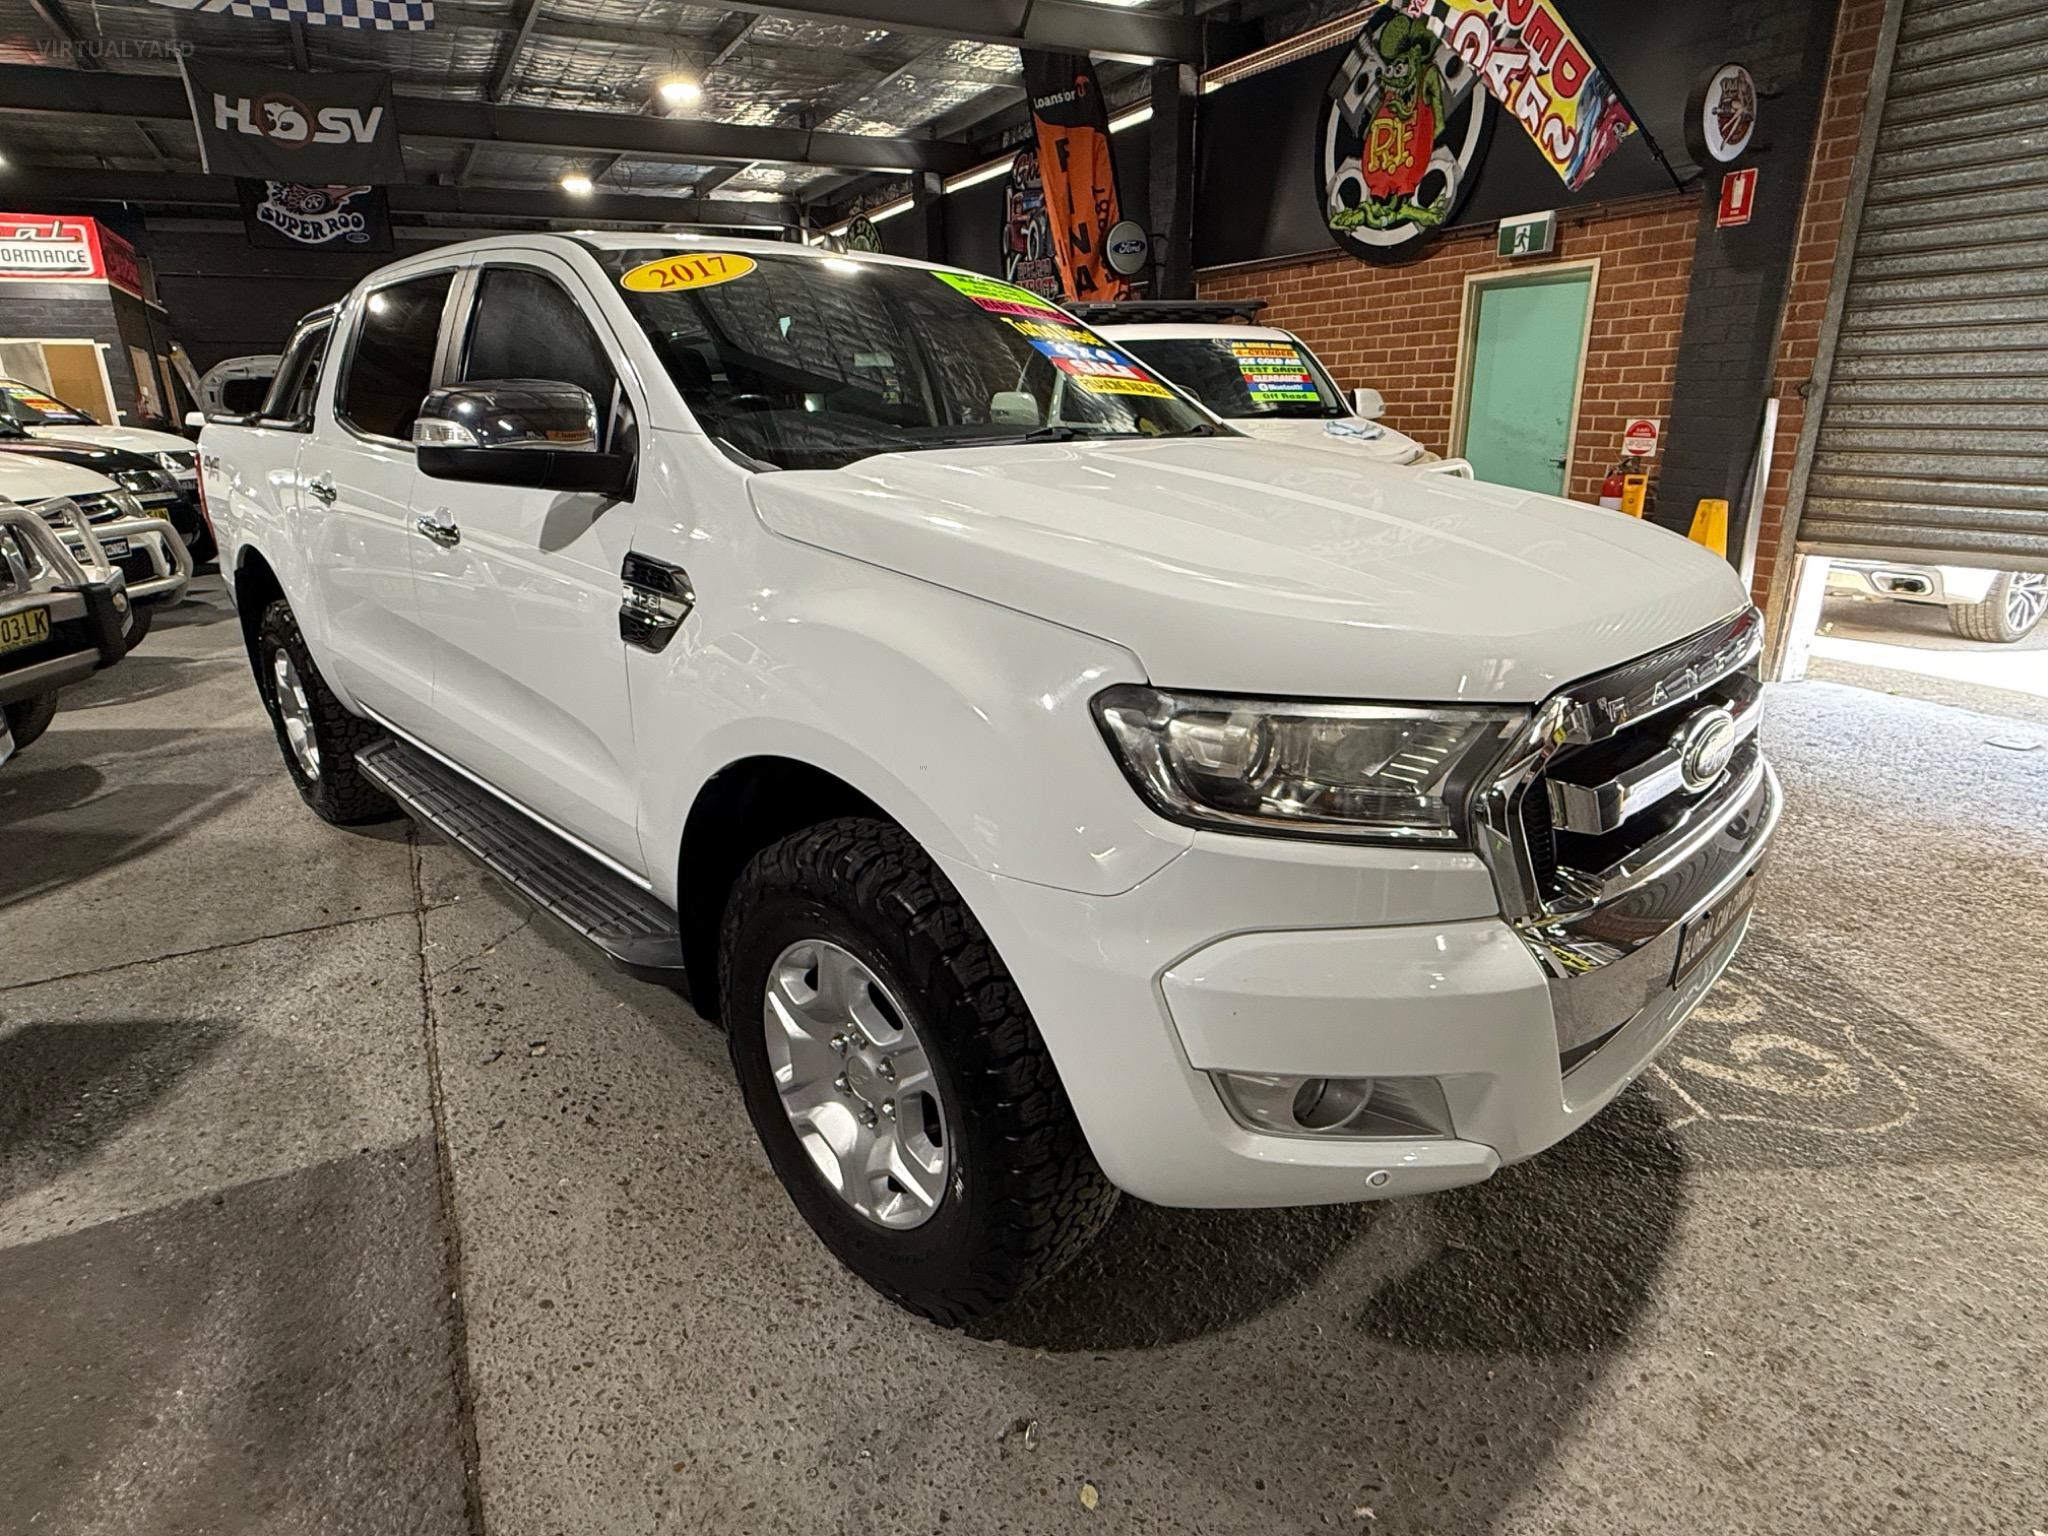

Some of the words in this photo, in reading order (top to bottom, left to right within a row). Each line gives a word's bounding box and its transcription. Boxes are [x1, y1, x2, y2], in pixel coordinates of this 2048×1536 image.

[261, 207, 326, 240] SUPER
[325, 215, 363, 234] ROO
[1, 248, 87, 264] ORMANCE
[1118, 239, 1144, 255] Ford
[648, 255, 729, 288] 2017
